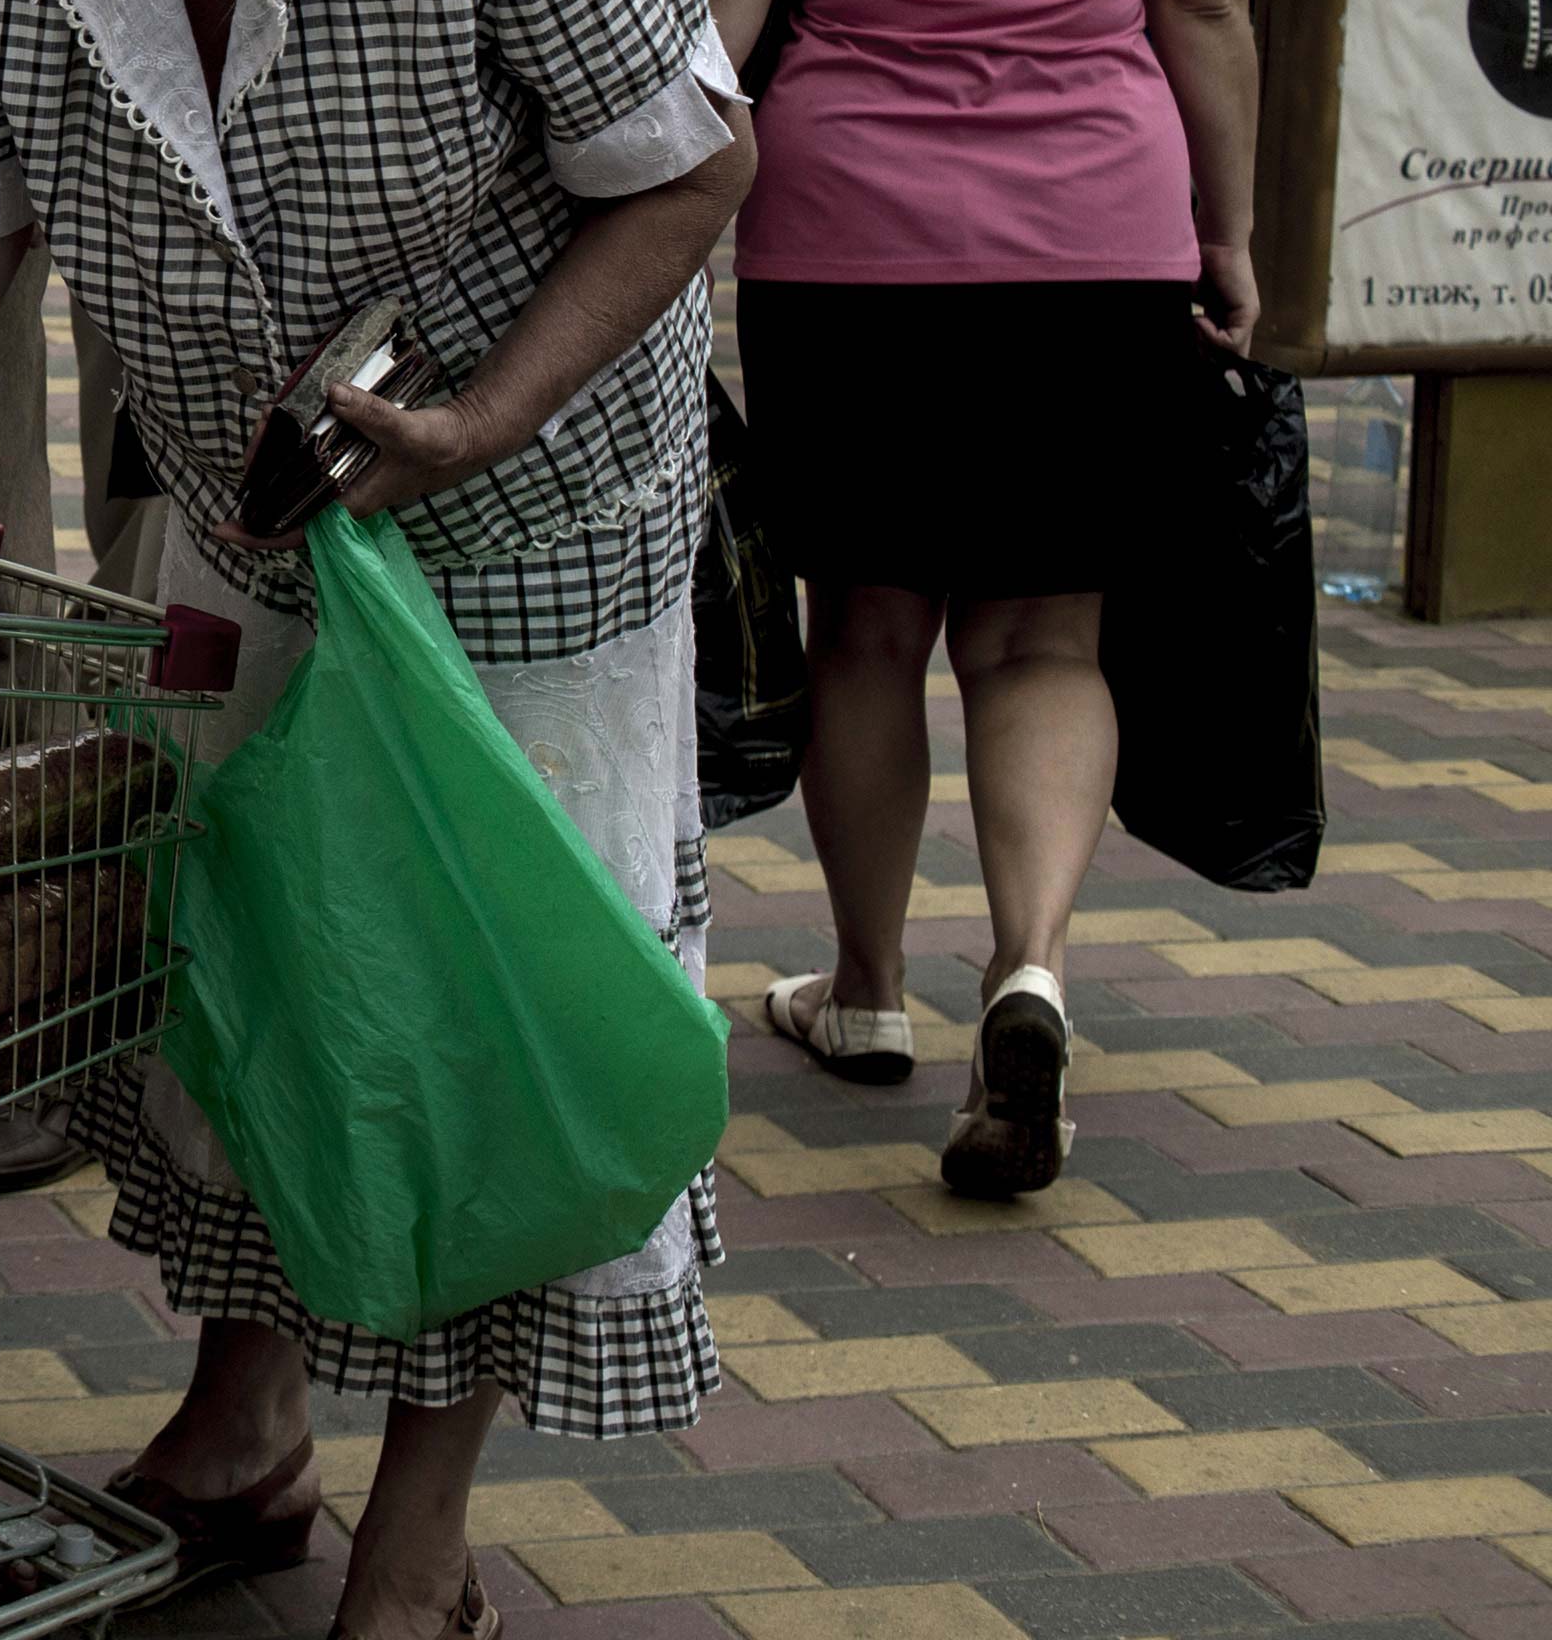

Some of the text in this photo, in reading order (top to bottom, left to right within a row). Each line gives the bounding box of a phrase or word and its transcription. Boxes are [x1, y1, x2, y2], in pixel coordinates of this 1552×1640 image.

[1501, 194, 1552, 221] Про
[1362, 276, 1375, 306] 1
[1387, 281, 1480, 312] этаж,
[1492, 283, 1516, 306] т.
